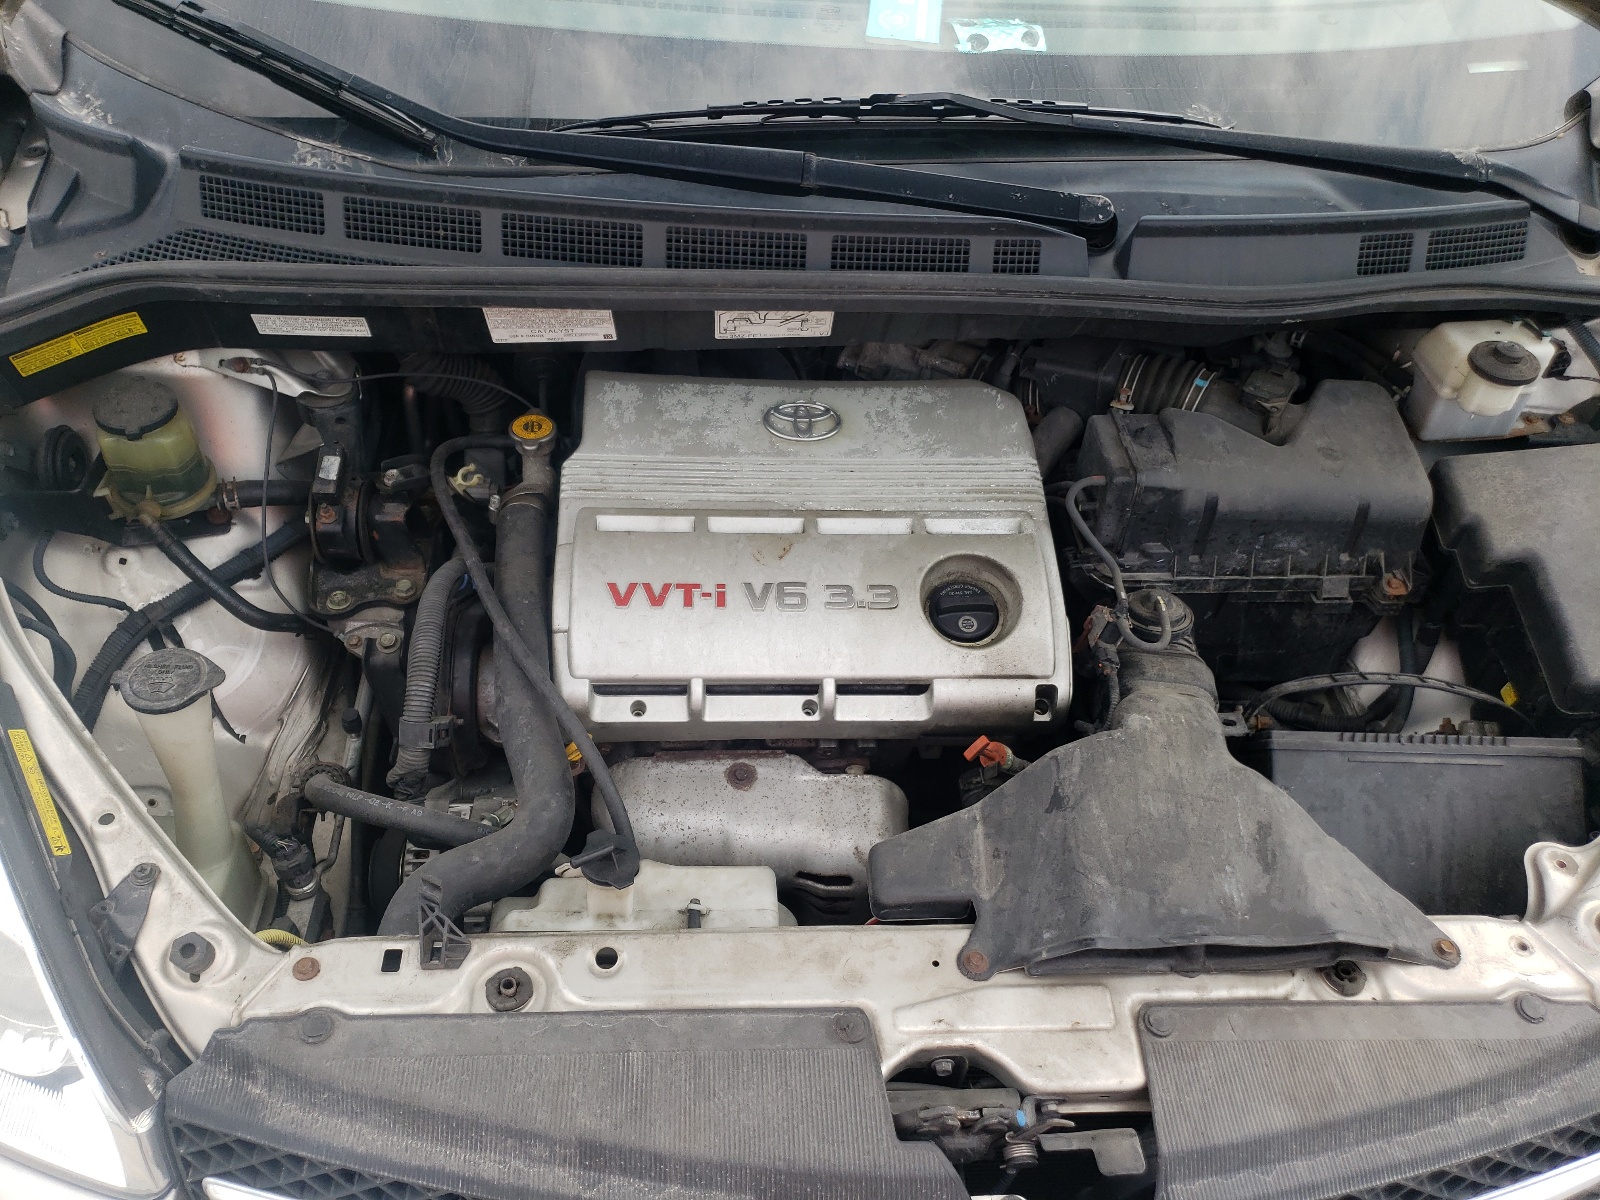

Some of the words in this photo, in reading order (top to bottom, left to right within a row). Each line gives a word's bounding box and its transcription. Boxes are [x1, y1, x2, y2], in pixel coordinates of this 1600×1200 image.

[606, 582, 728, 609] VVT-i
[742, 582, 809, 612] V6
[823, 584, 900, 610] 3.3
